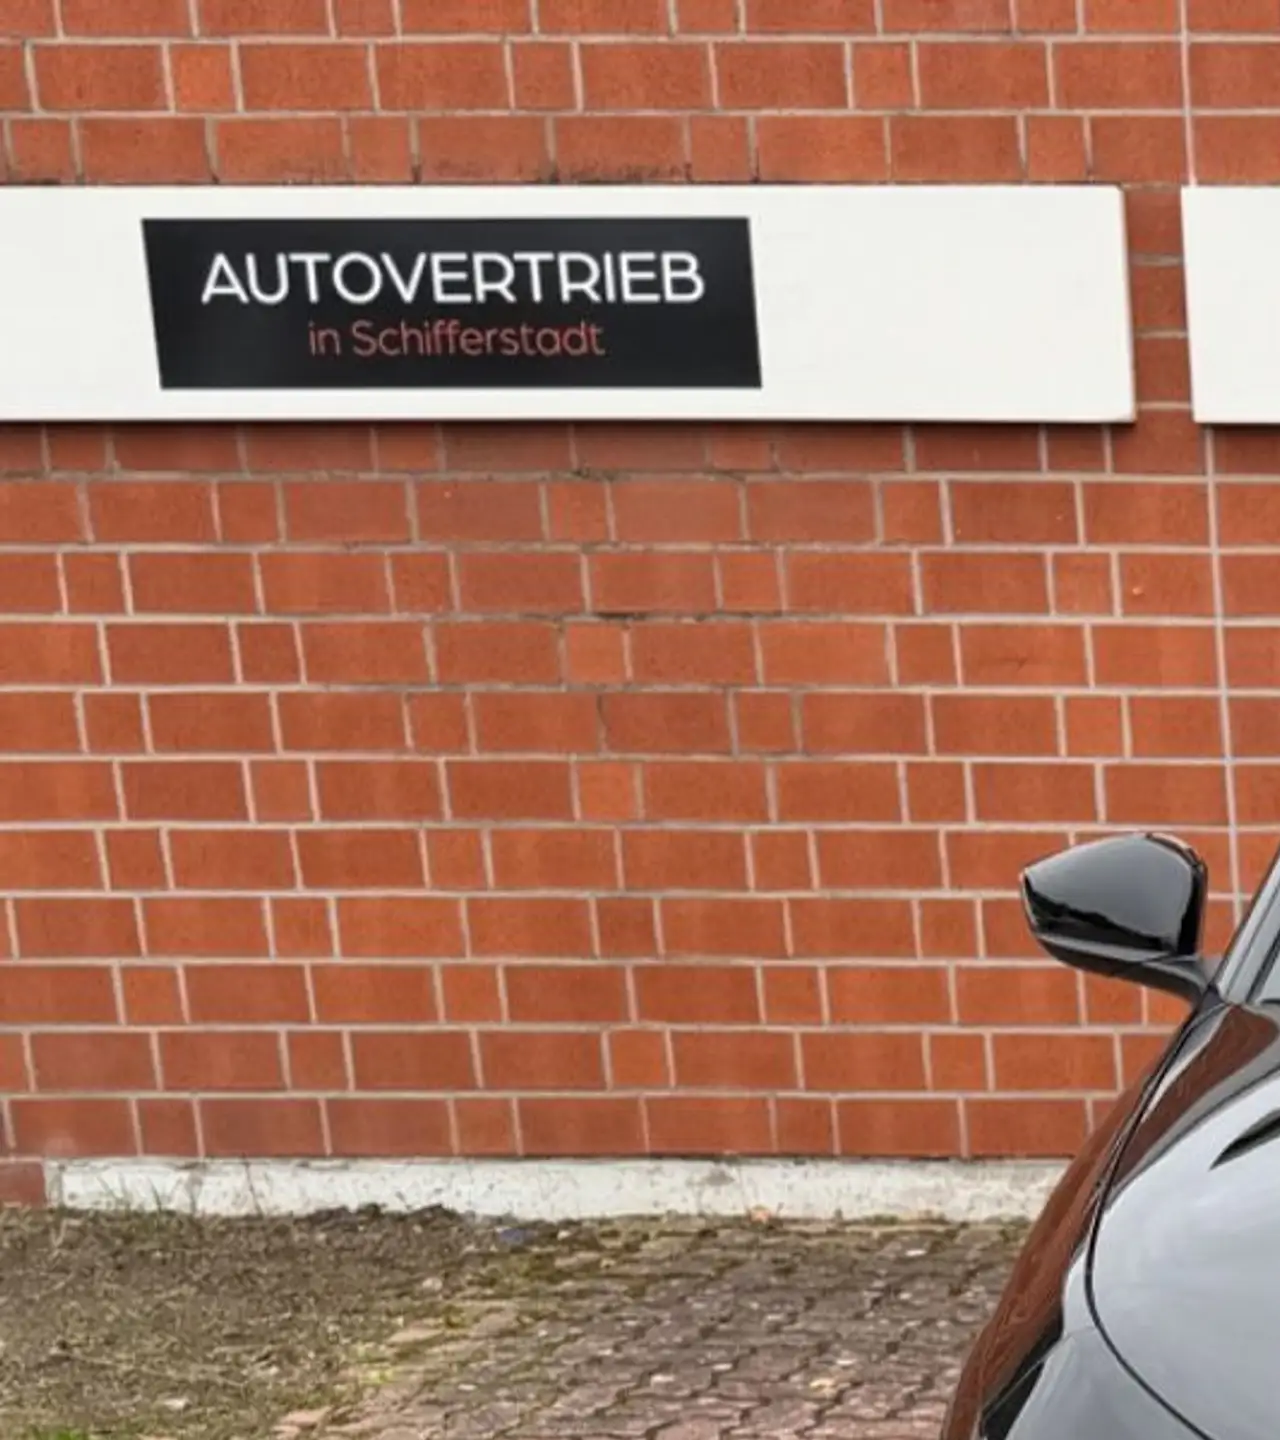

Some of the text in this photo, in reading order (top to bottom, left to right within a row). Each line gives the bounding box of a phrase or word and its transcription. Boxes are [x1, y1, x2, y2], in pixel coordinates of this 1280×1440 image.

[201, 251, 706, 305] AUTOVERTRIEB
[308, 318, 606, 358] in Schifferstadt
